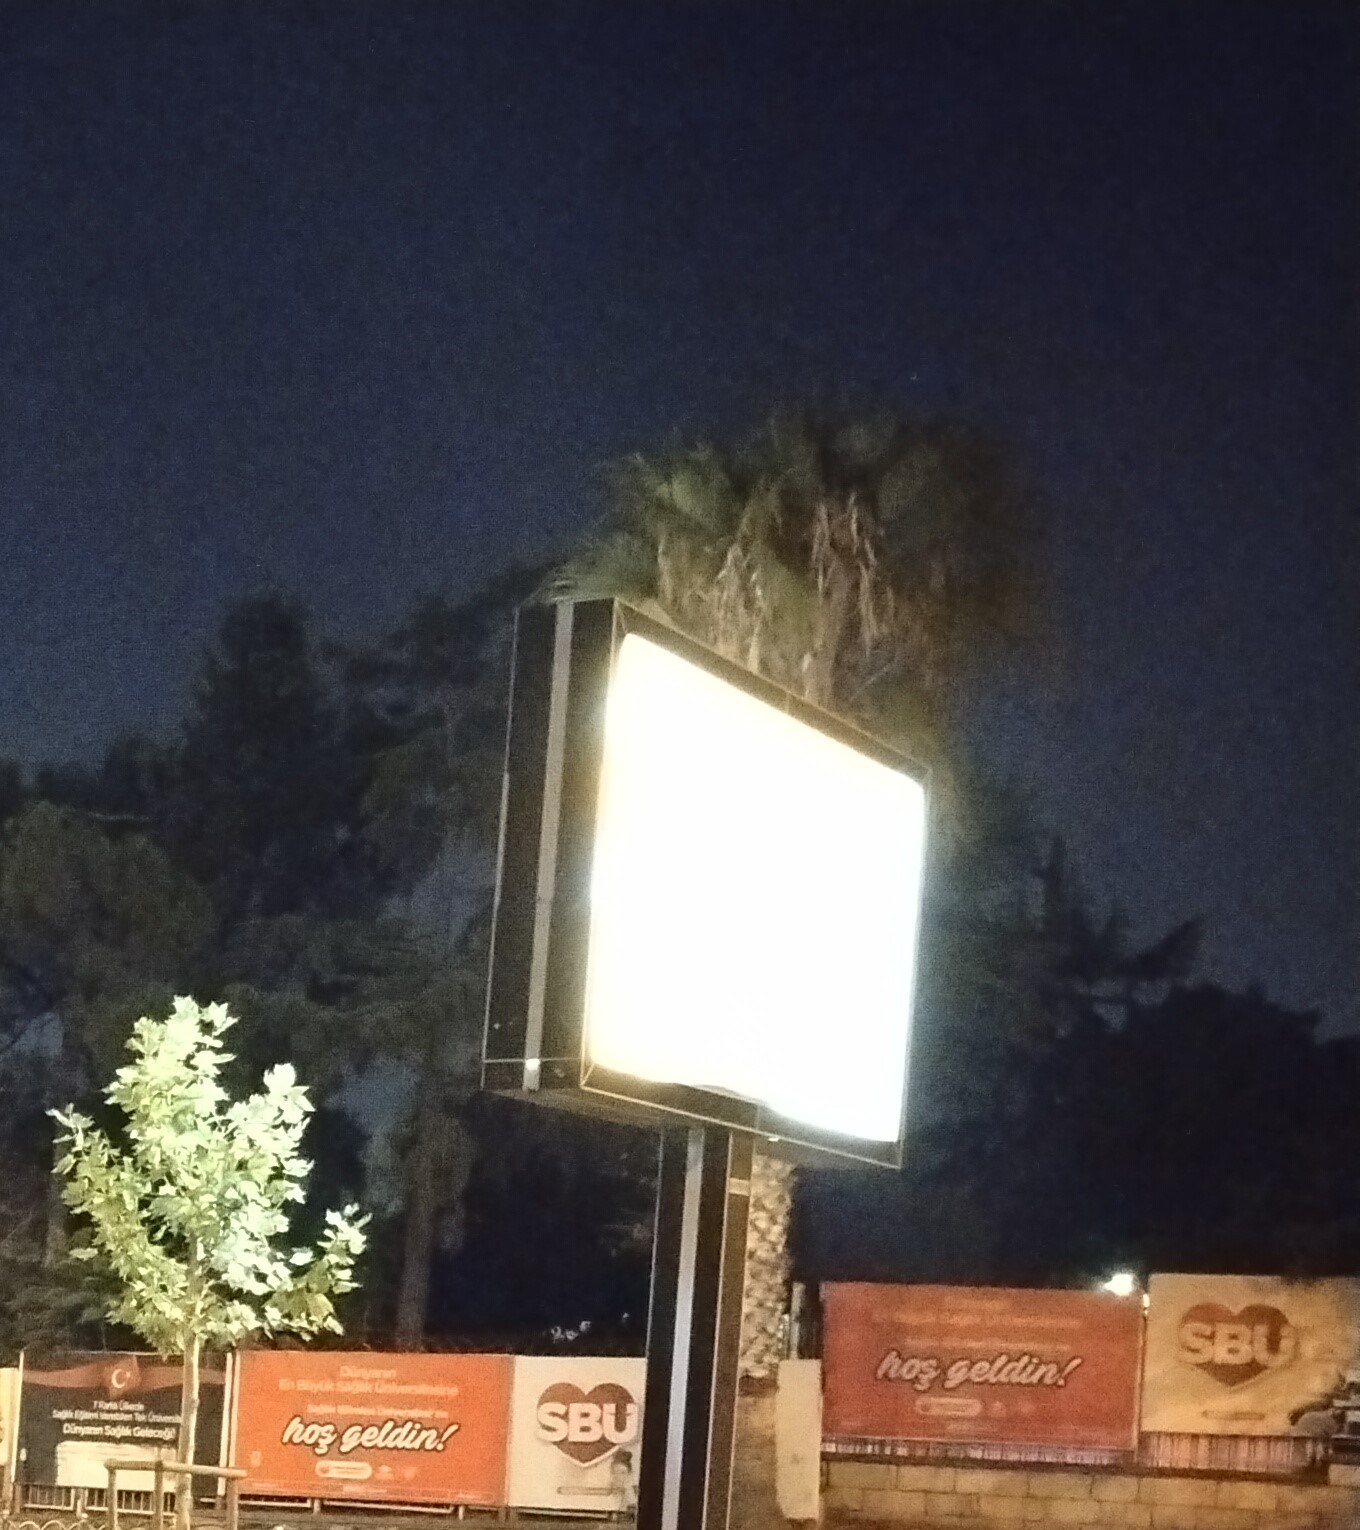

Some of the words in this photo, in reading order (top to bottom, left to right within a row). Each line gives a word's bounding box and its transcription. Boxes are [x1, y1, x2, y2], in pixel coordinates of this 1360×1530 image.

[876, 1350, 940, 1391] hoş
[943, 1354, 1082, 1389] geldin!
[282, 1416, 338, 1455] hoş
[339, 1420, 460, 1453] geldin!
